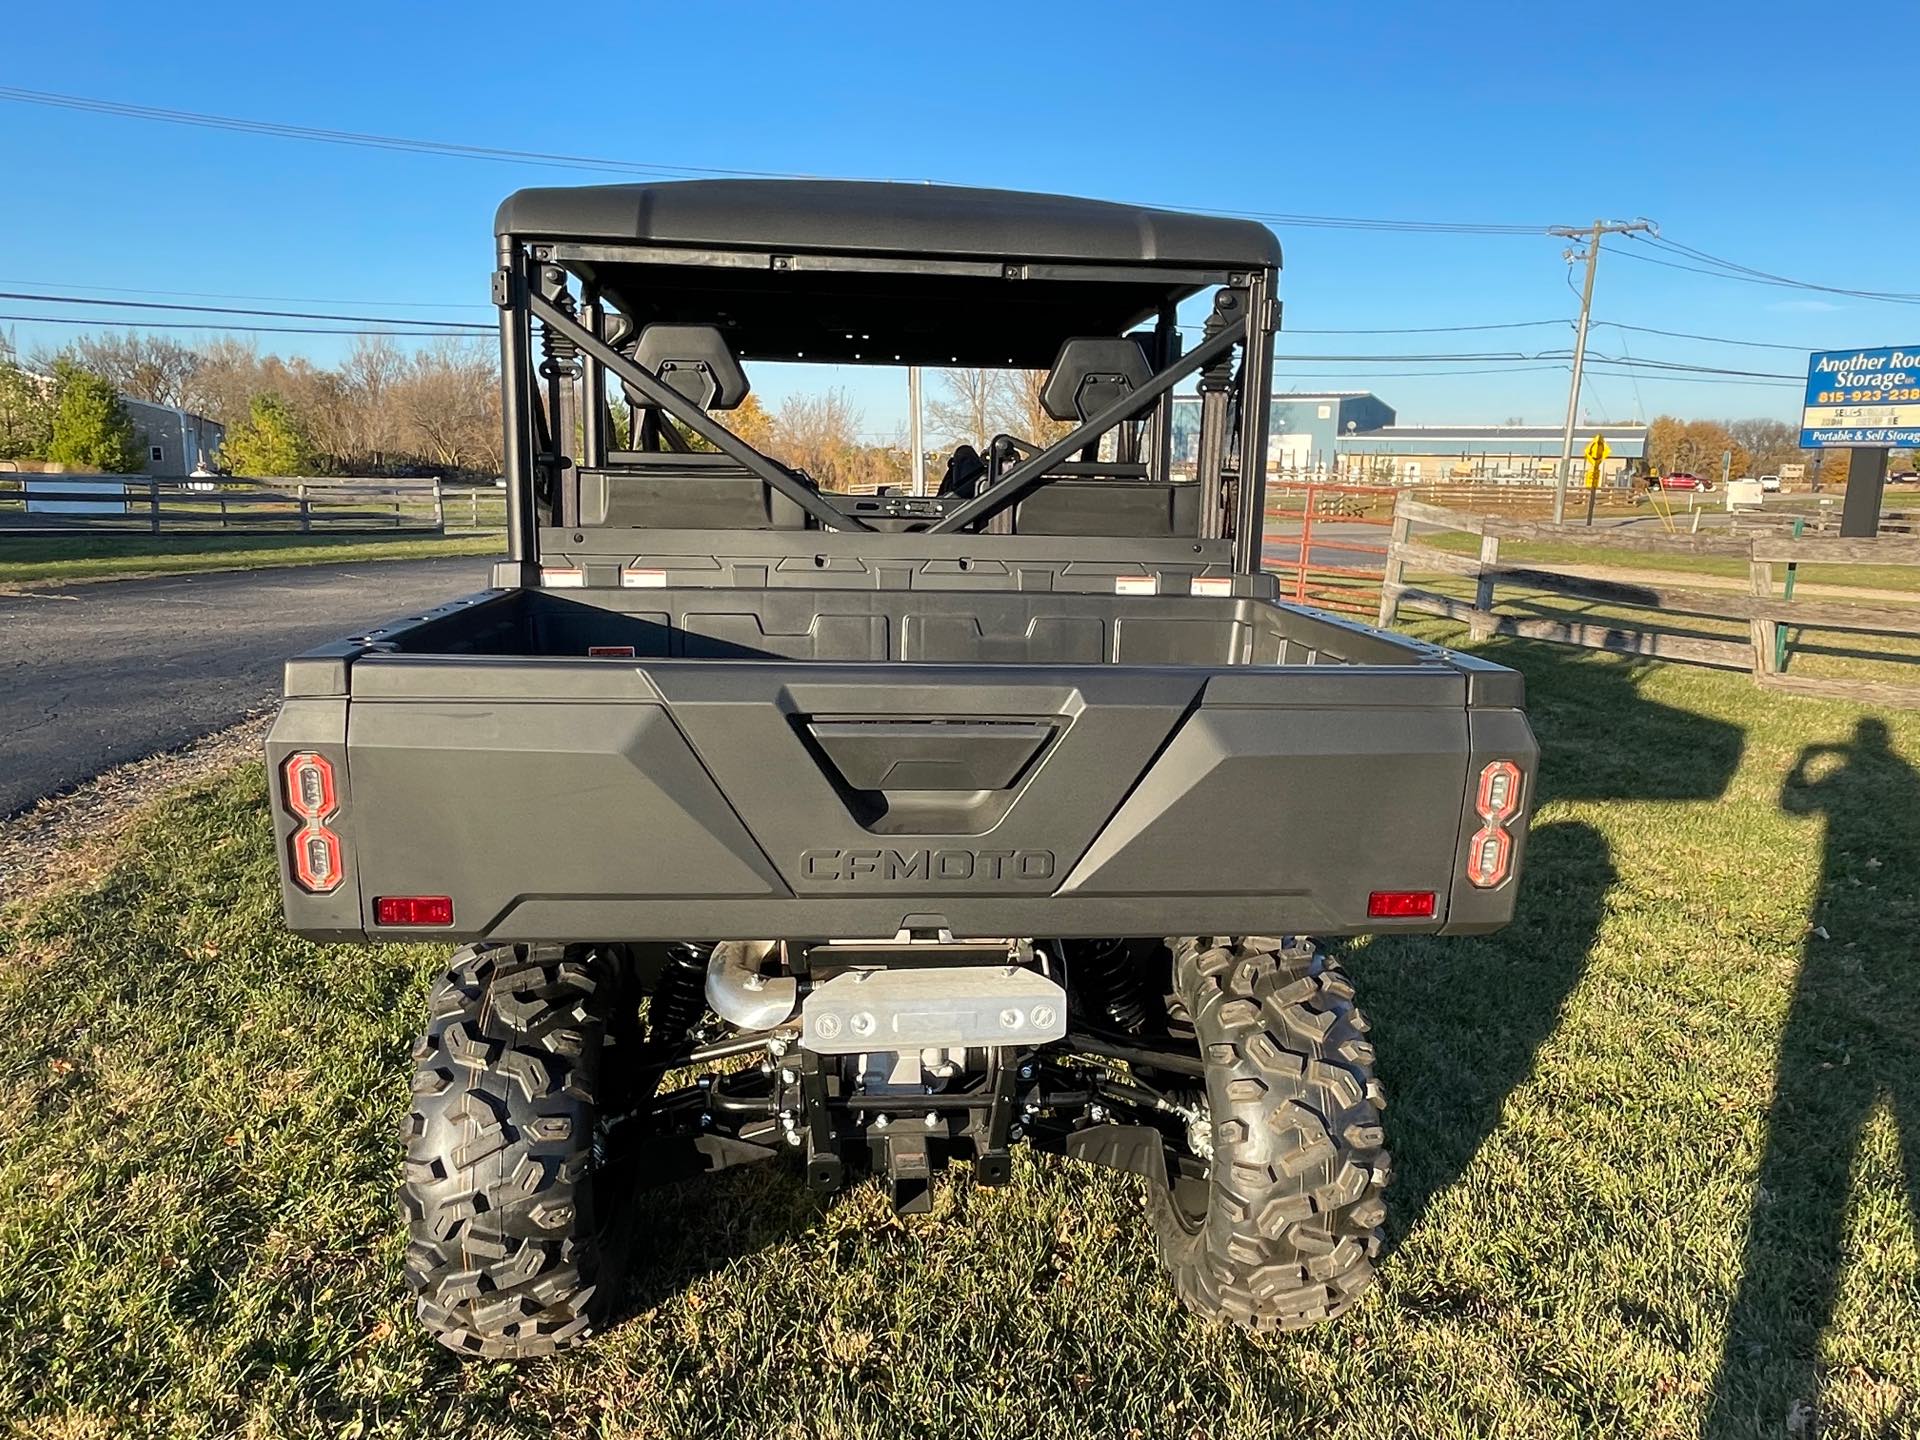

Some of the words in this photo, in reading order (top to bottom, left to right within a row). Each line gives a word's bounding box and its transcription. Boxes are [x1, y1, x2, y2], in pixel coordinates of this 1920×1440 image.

[1815, 353, 1887, 372] Another
[1835, 371, 1906, 391] Storage
[1812, 430, 1853, 441] Portable
[1854, 430, 1863, 438] &
[1865, 429, 1886, 438] Self
[800, 849, 1056, 880] CFMOTO
